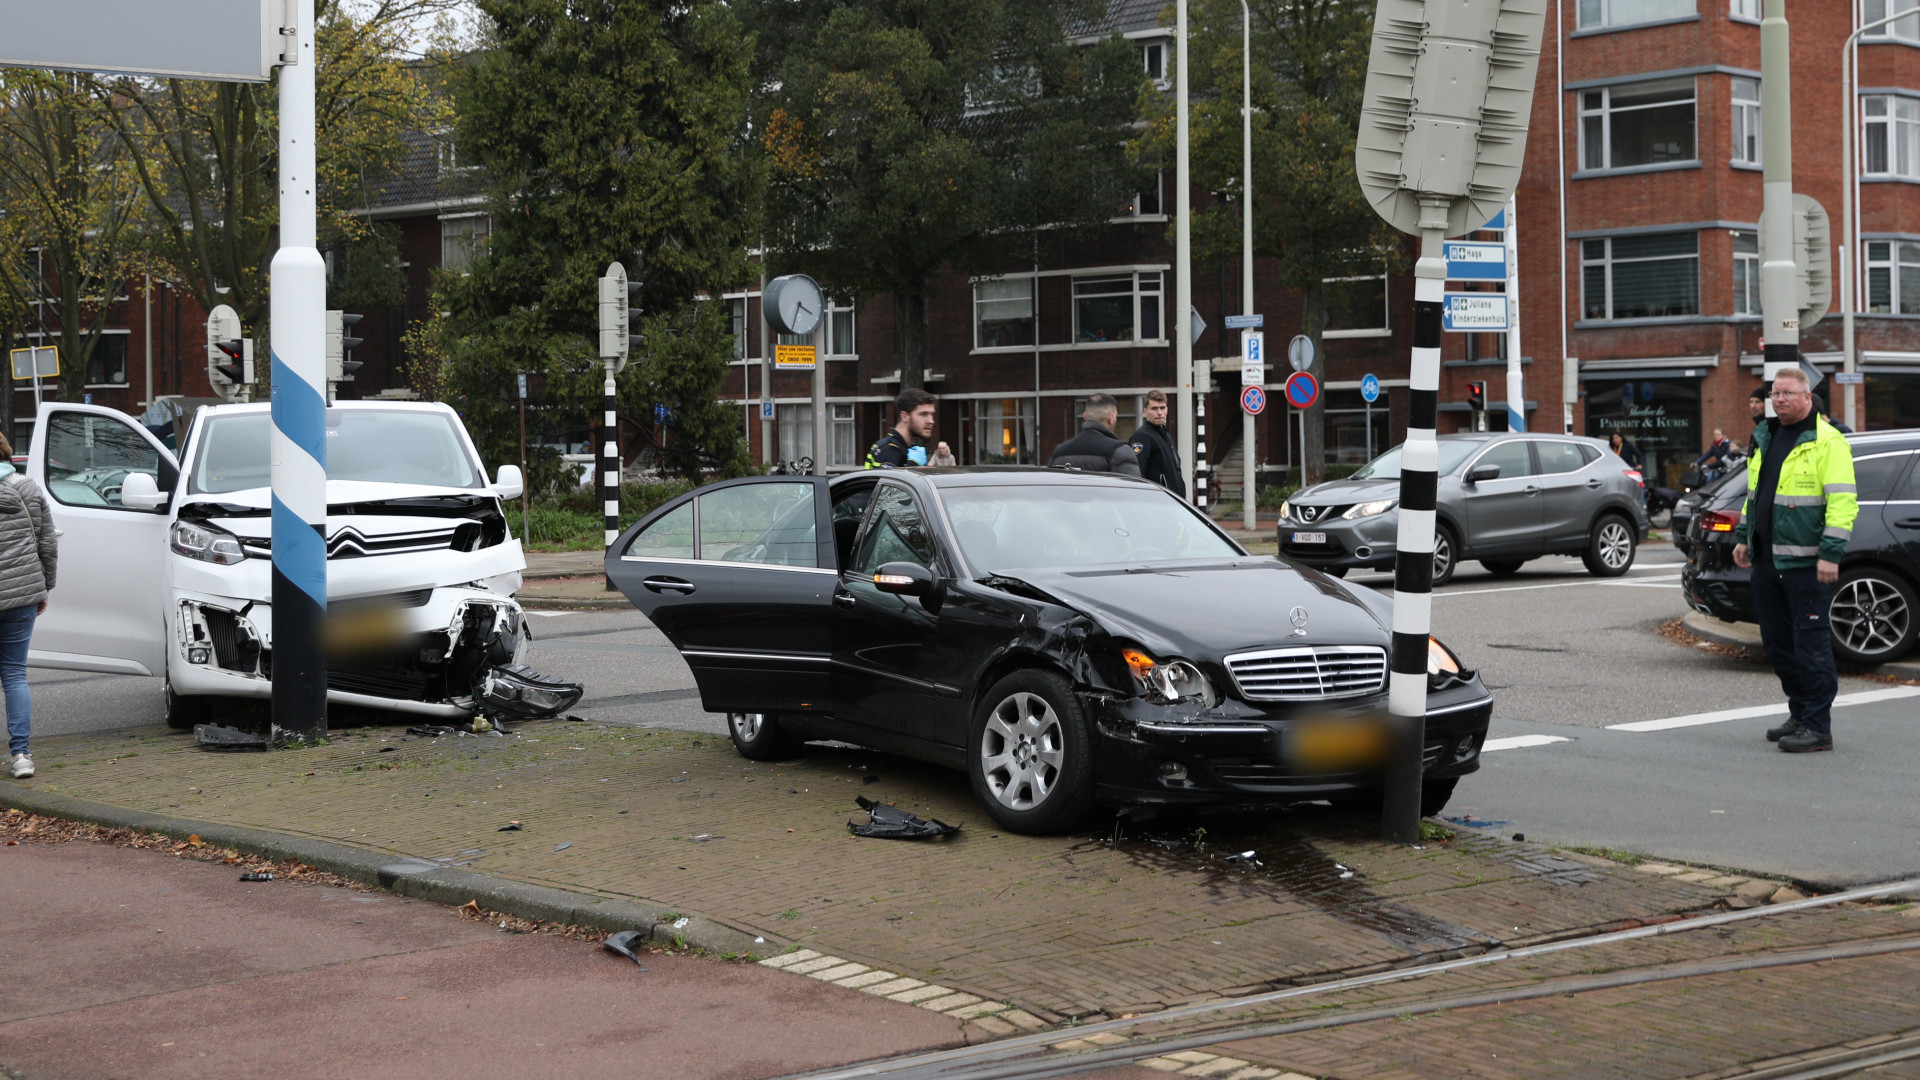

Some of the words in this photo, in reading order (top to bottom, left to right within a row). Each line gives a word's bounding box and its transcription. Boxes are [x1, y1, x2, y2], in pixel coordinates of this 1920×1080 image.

[1468, 301, 1492, 309] Juliana
[1453, 314, 1505, 323] Kinderziekenhuis
[1642, 417, 1653, 428] &
